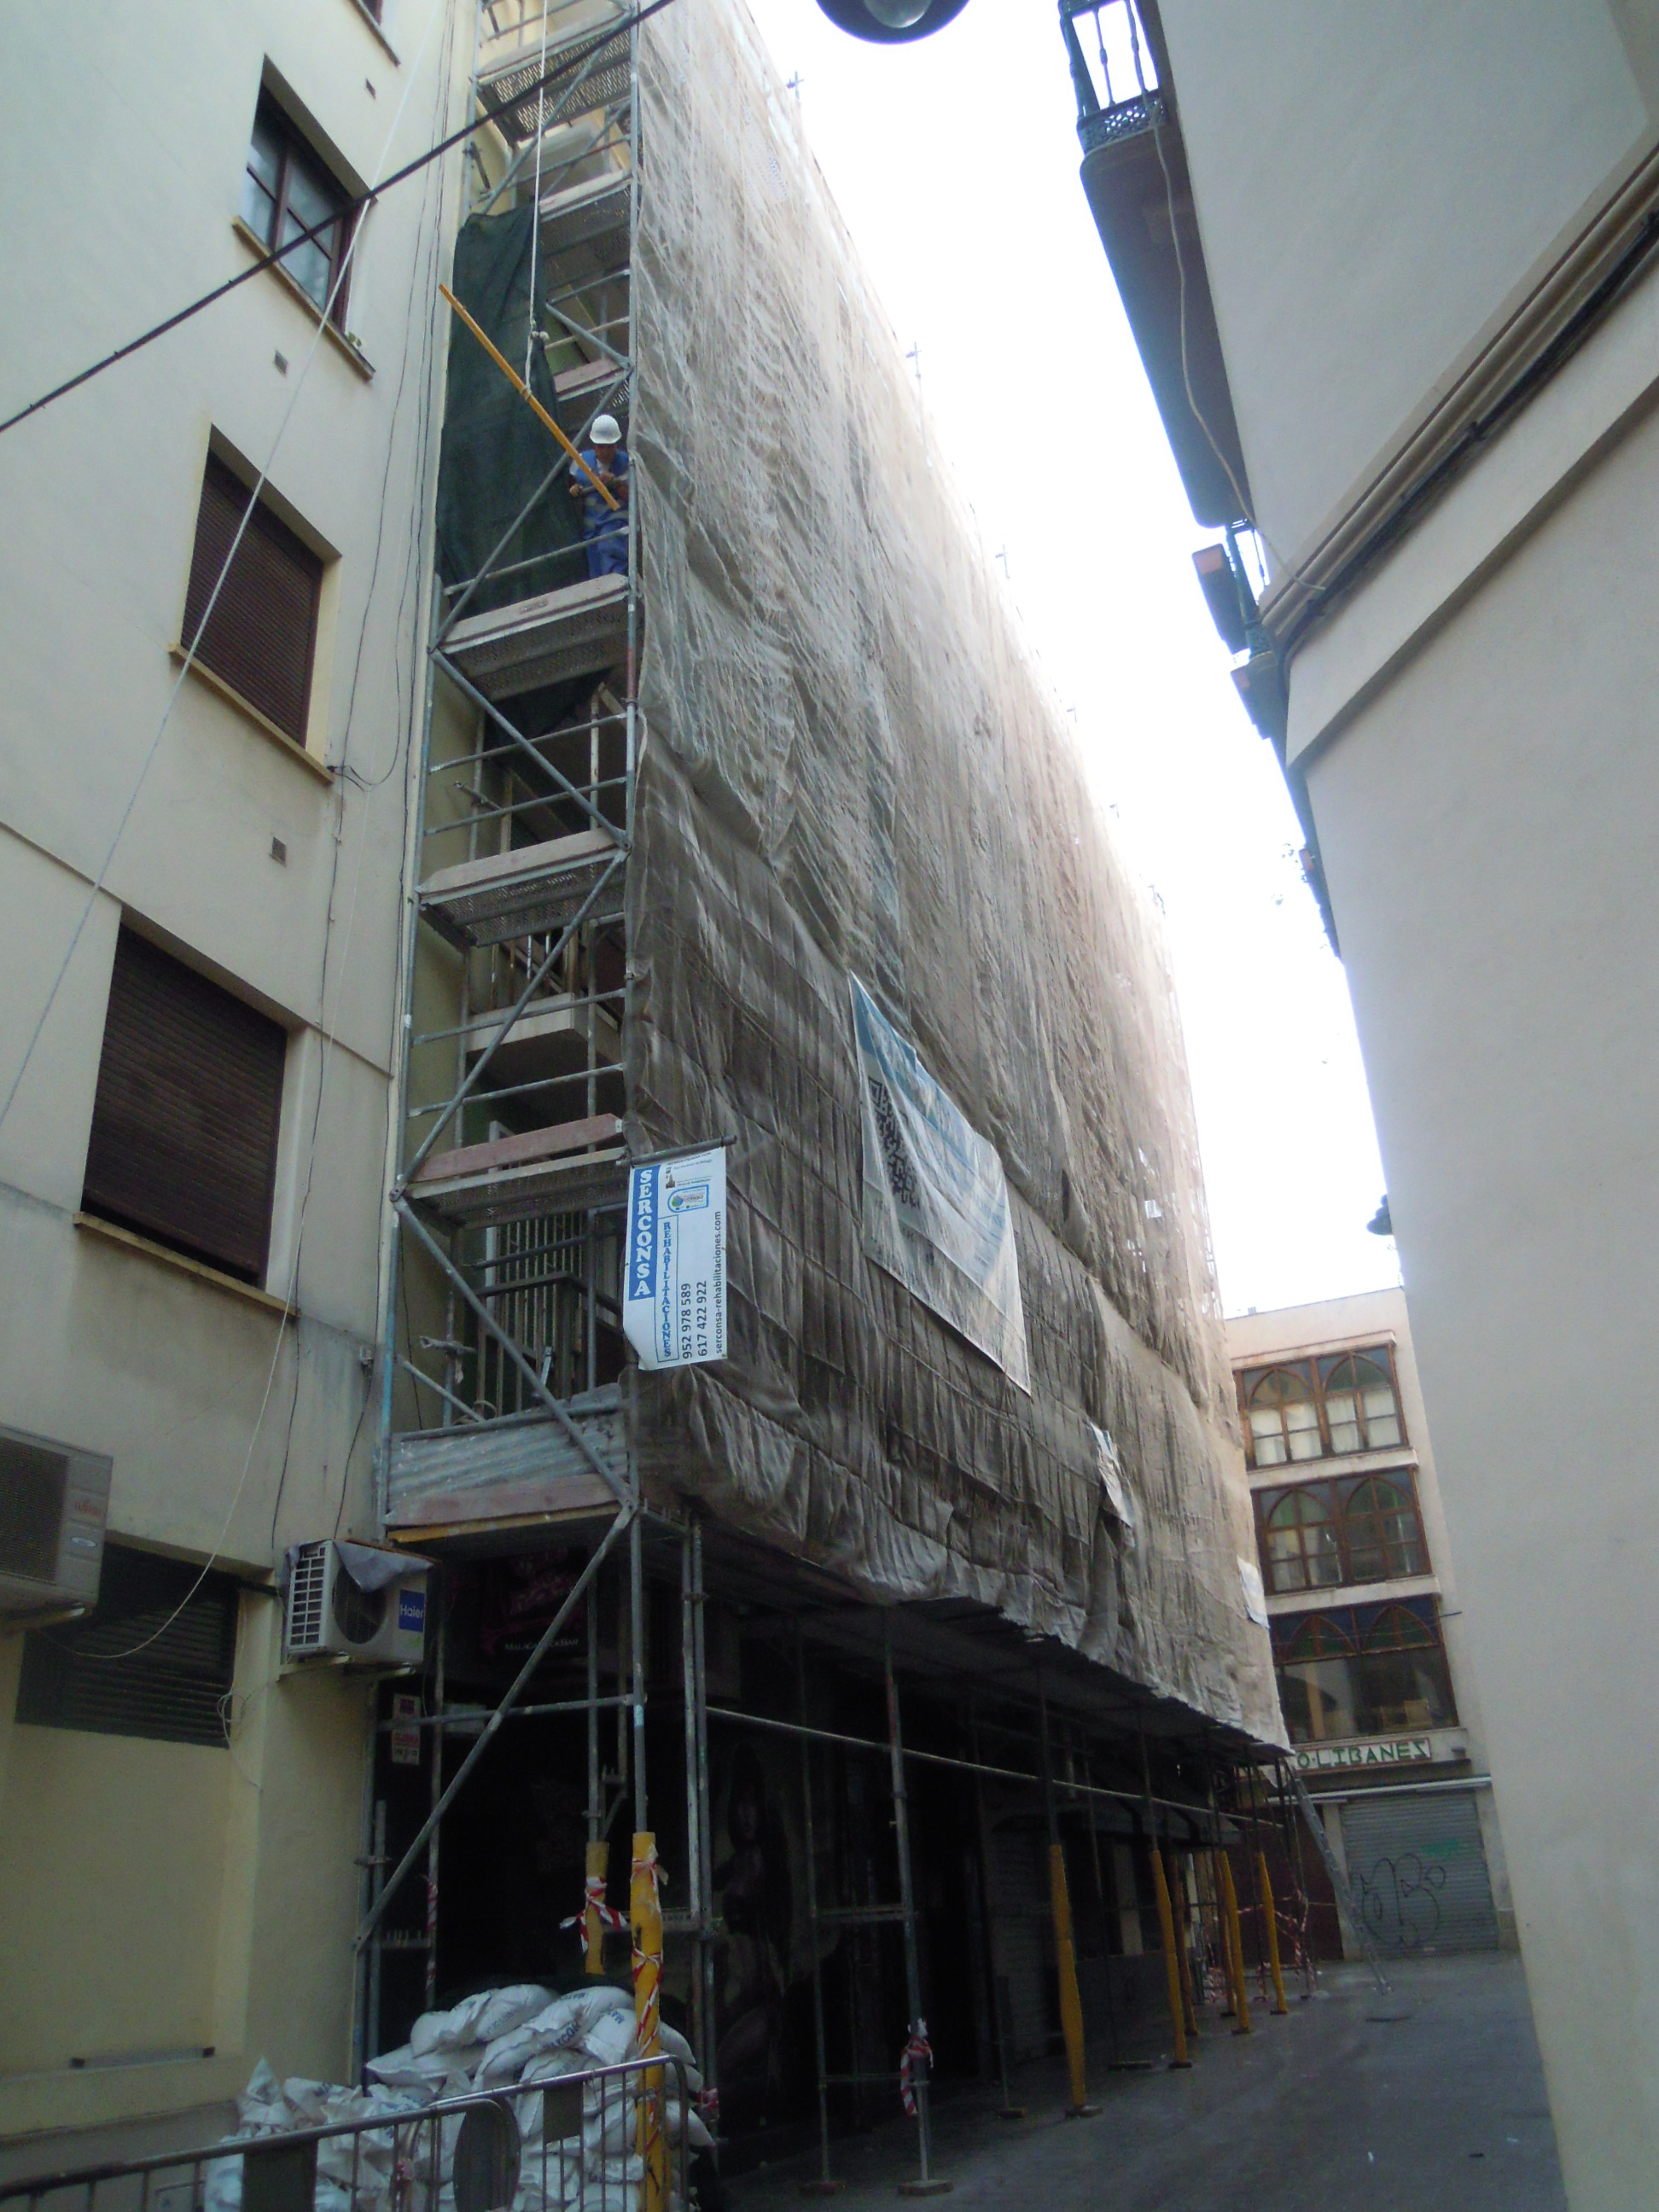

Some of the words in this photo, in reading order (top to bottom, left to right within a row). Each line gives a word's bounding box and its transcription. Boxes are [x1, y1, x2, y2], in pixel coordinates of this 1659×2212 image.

[634, 1168, 654, 1297] SERCONSA
[661, 1221, 672, 1358] REHABILITACIONES
[696, 1281, 707, 1304] 922
[713, 1211, 723, 1354] serconsa-rehabilitaciones.com
[680, 1283, 691, 1306] 589
[681, 1309, 692, 1332] 978
[696, 1307, 707, 1330] 422
[681, 1335, 693, 1359] 952
[696, 1334, 708, 1357] 617
[399, 1604, 423, 1619] Haier
